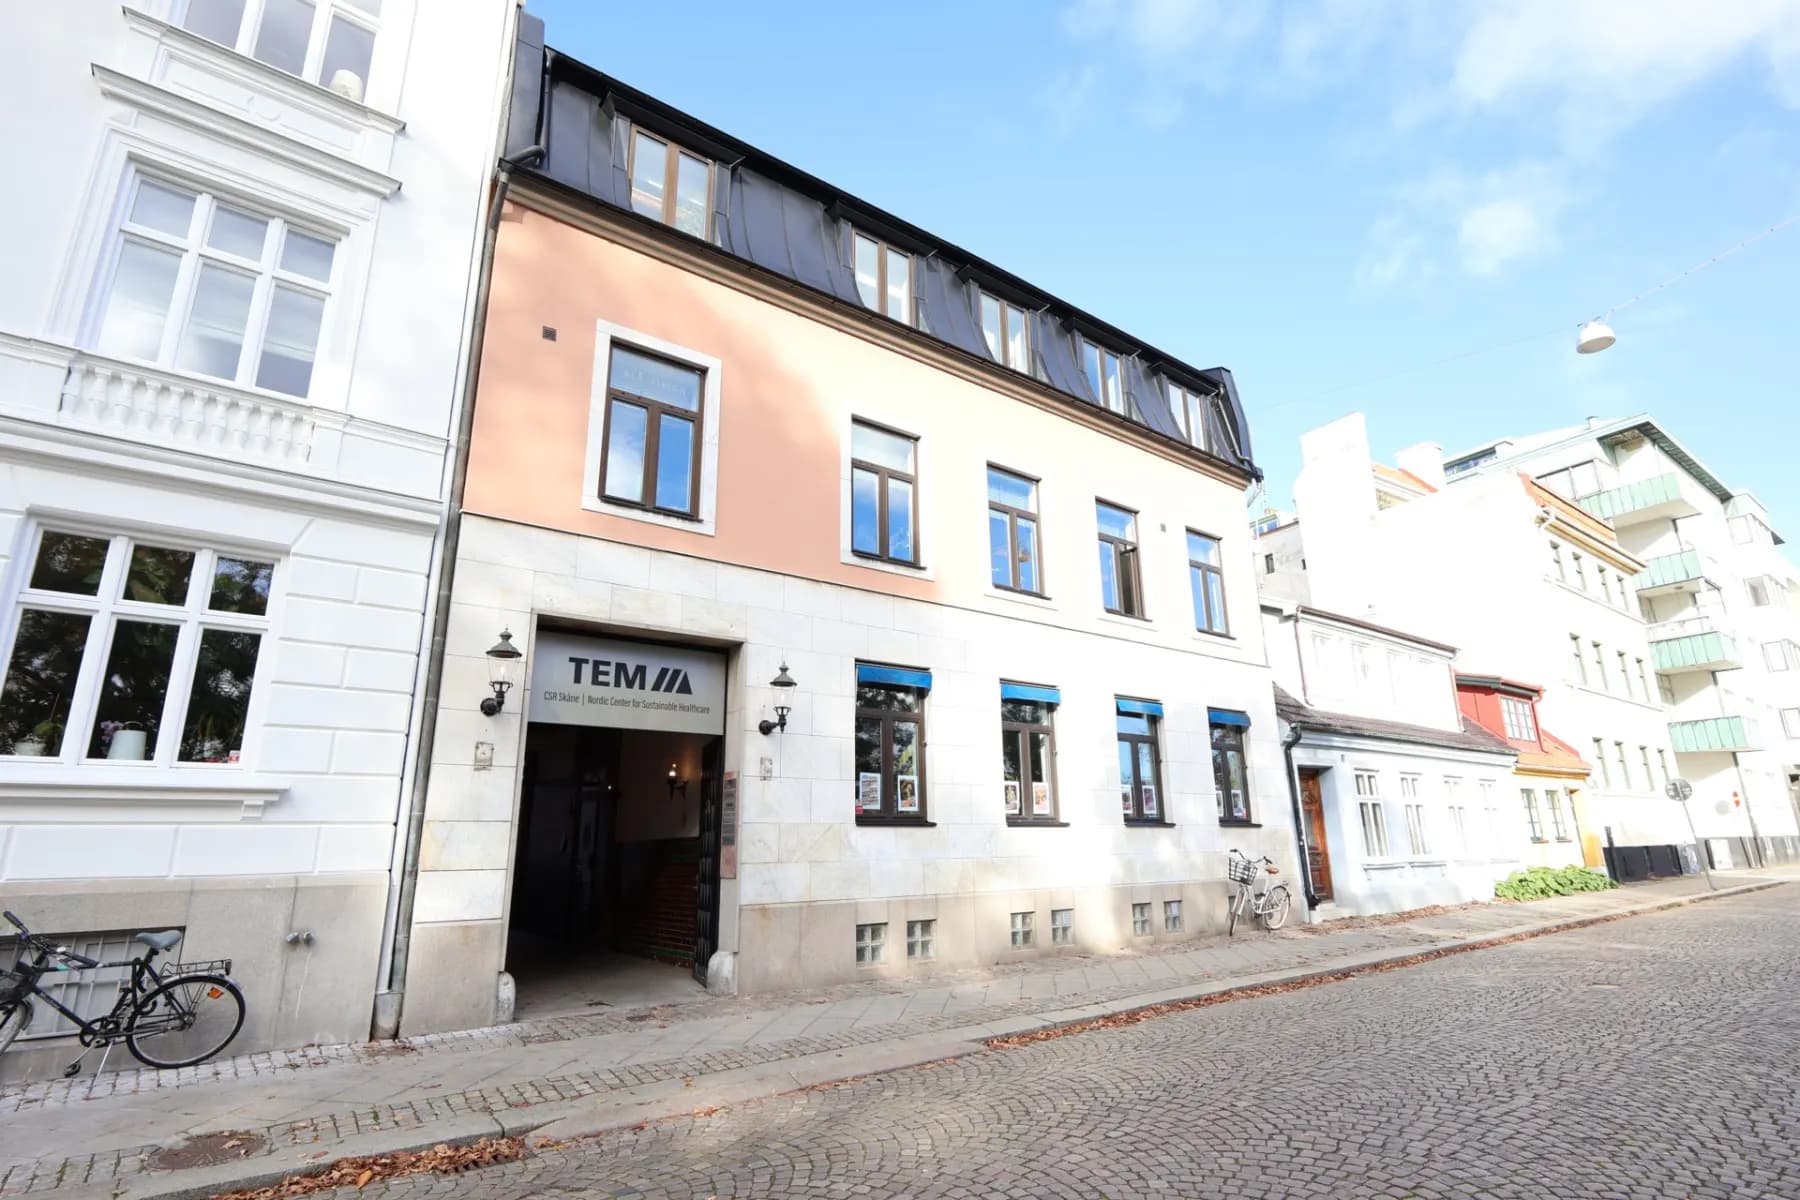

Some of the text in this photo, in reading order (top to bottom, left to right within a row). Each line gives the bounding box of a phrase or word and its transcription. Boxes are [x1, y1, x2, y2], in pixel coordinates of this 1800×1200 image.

[568, 656, 647, 690] TEM
[544, 690, 580, 704] CSR Skåne
[587, 694, 710, 715] Nordic Center for Sustainable Healthcare
